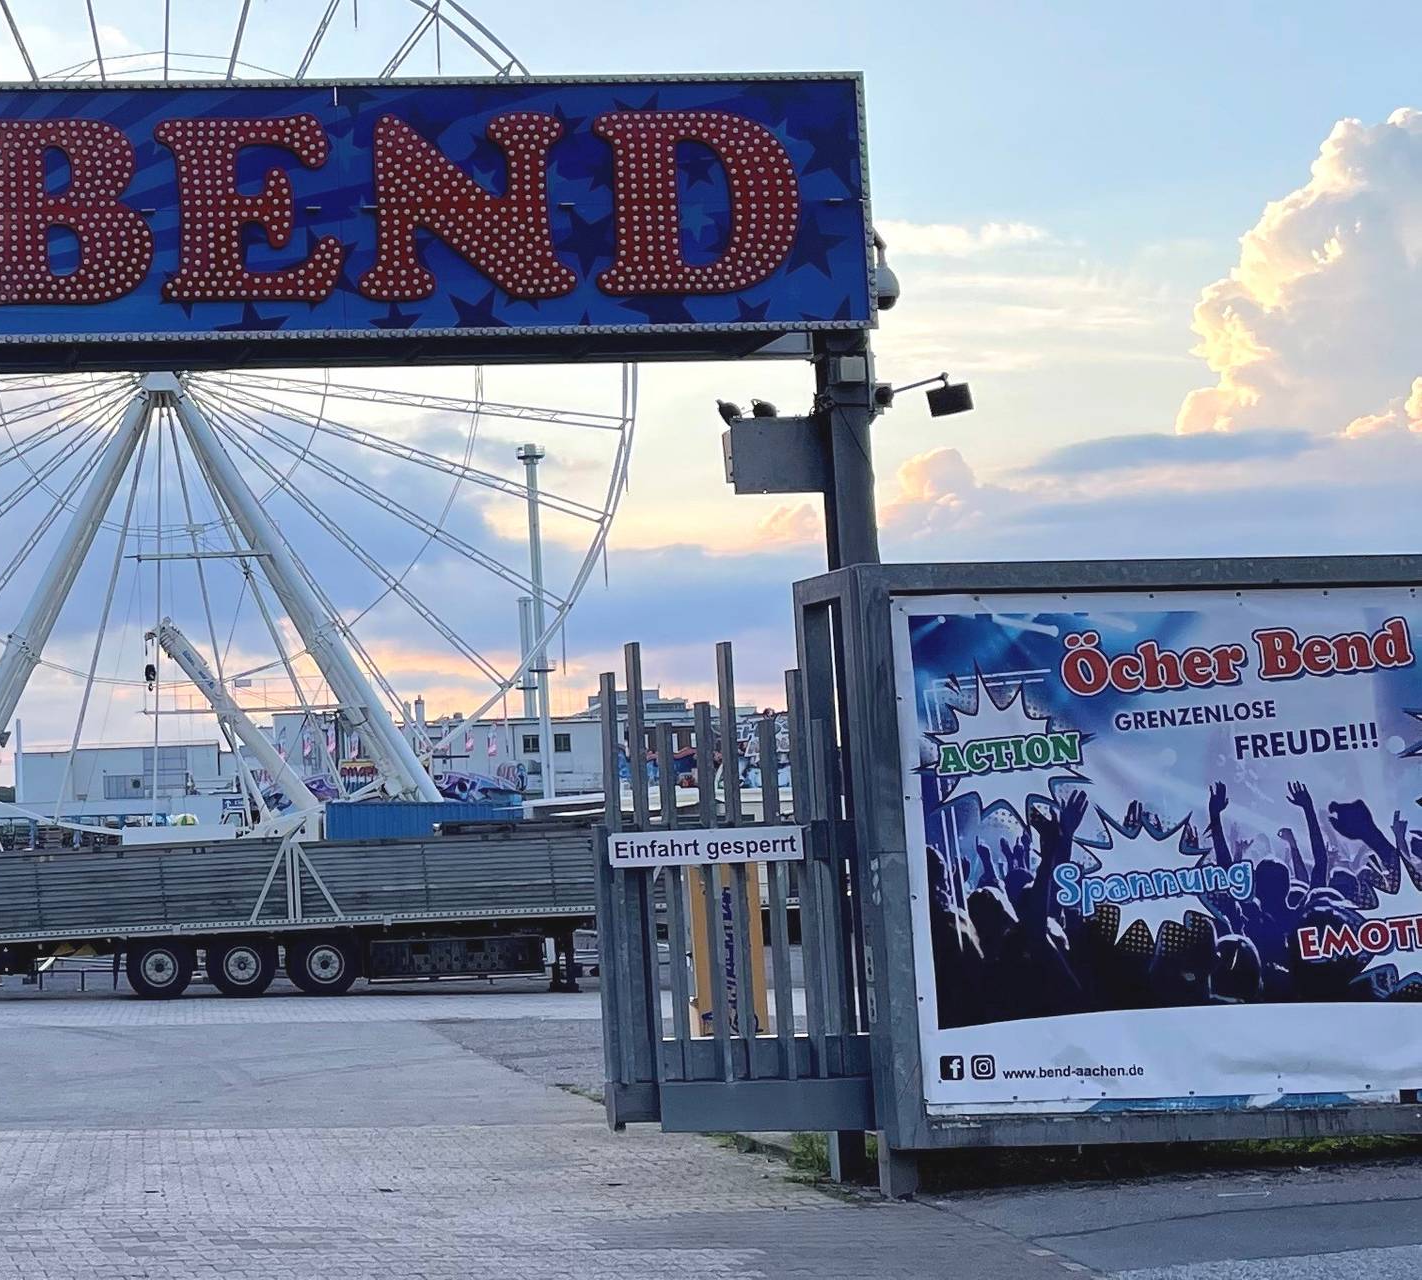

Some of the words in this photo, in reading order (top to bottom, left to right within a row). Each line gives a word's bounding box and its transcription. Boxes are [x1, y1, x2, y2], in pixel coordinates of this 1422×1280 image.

[1061, 630, 1246, 697] Öcher
[1253, 617, 1414, 681] Bend
[1114, 700, 1276, 731] GRENZENLOSE
[938, 732, 1081, 775] ACTION
[1234, 722, 1379, 760] FREUDE!!!
[614, 838, 699, 859] Einfahrt
[706, 835, 797, 860] gesperrt
[1053, 860, 1254, 915] Spannung
[1002, 1064, 1145, 1079] www.bend-aachen.de
